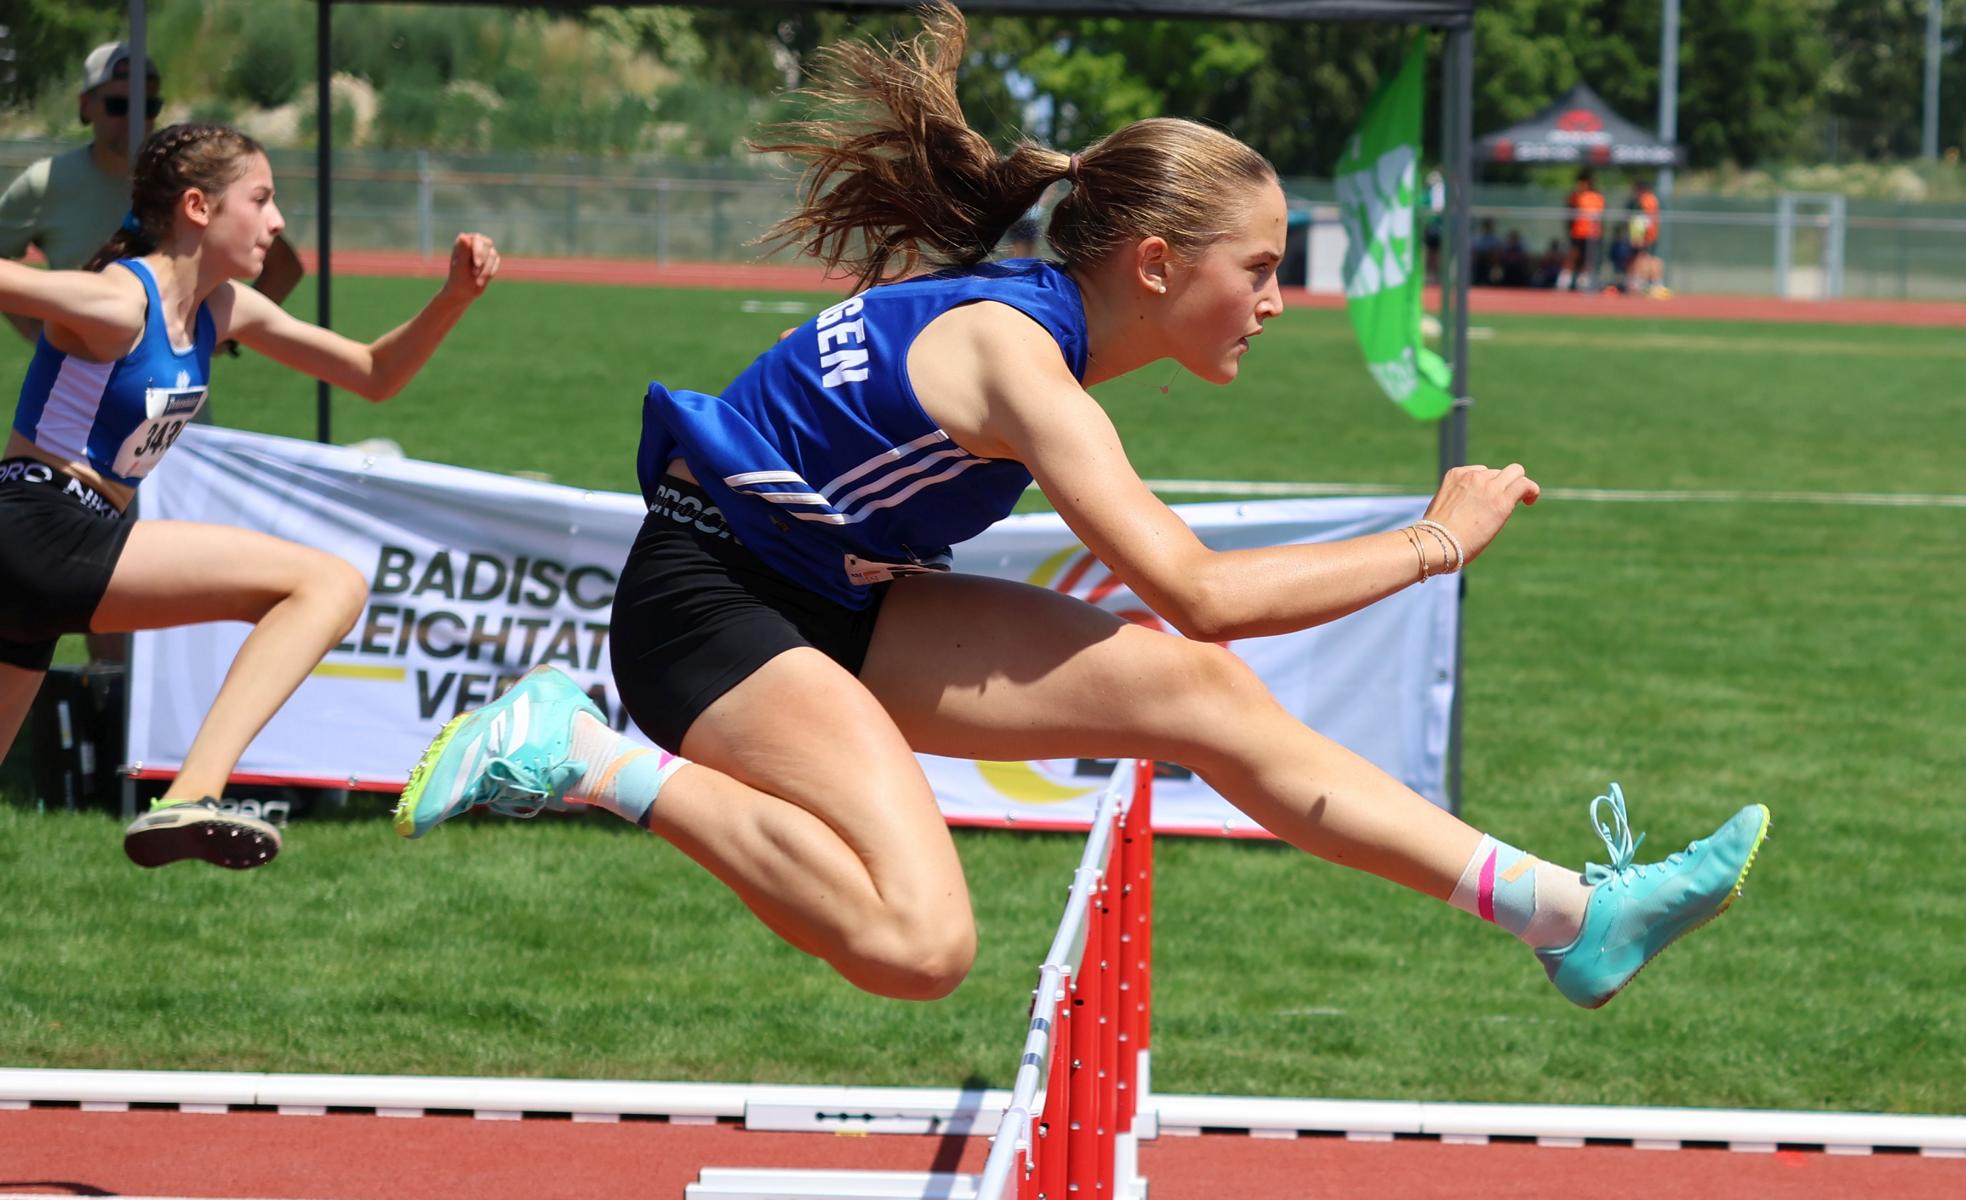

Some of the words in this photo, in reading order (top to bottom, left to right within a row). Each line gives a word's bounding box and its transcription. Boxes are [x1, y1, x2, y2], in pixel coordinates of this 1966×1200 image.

[816, 288, 870, 388] GEN
[371, 546, 616, 611] BADISC
[332, 603, 610, 671] EICHTAT
